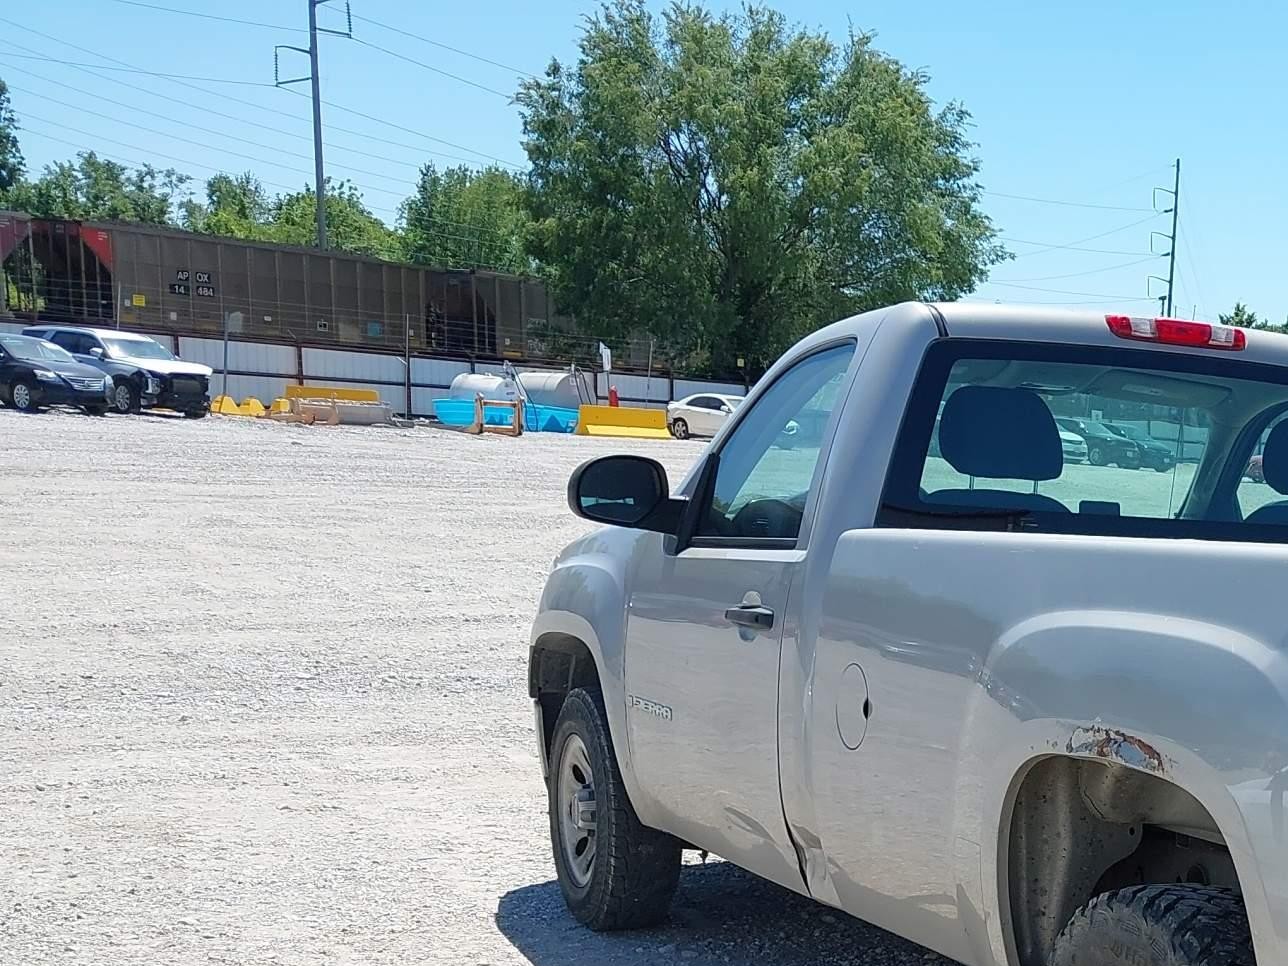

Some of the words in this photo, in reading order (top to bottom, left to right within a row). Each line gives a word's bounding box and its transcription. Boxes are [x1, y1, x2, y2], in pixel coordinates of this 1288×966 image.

[177, 271, 189, 280] AP
[196, 272, 209, 282] OX
[174, 285, 185, 294] 14
